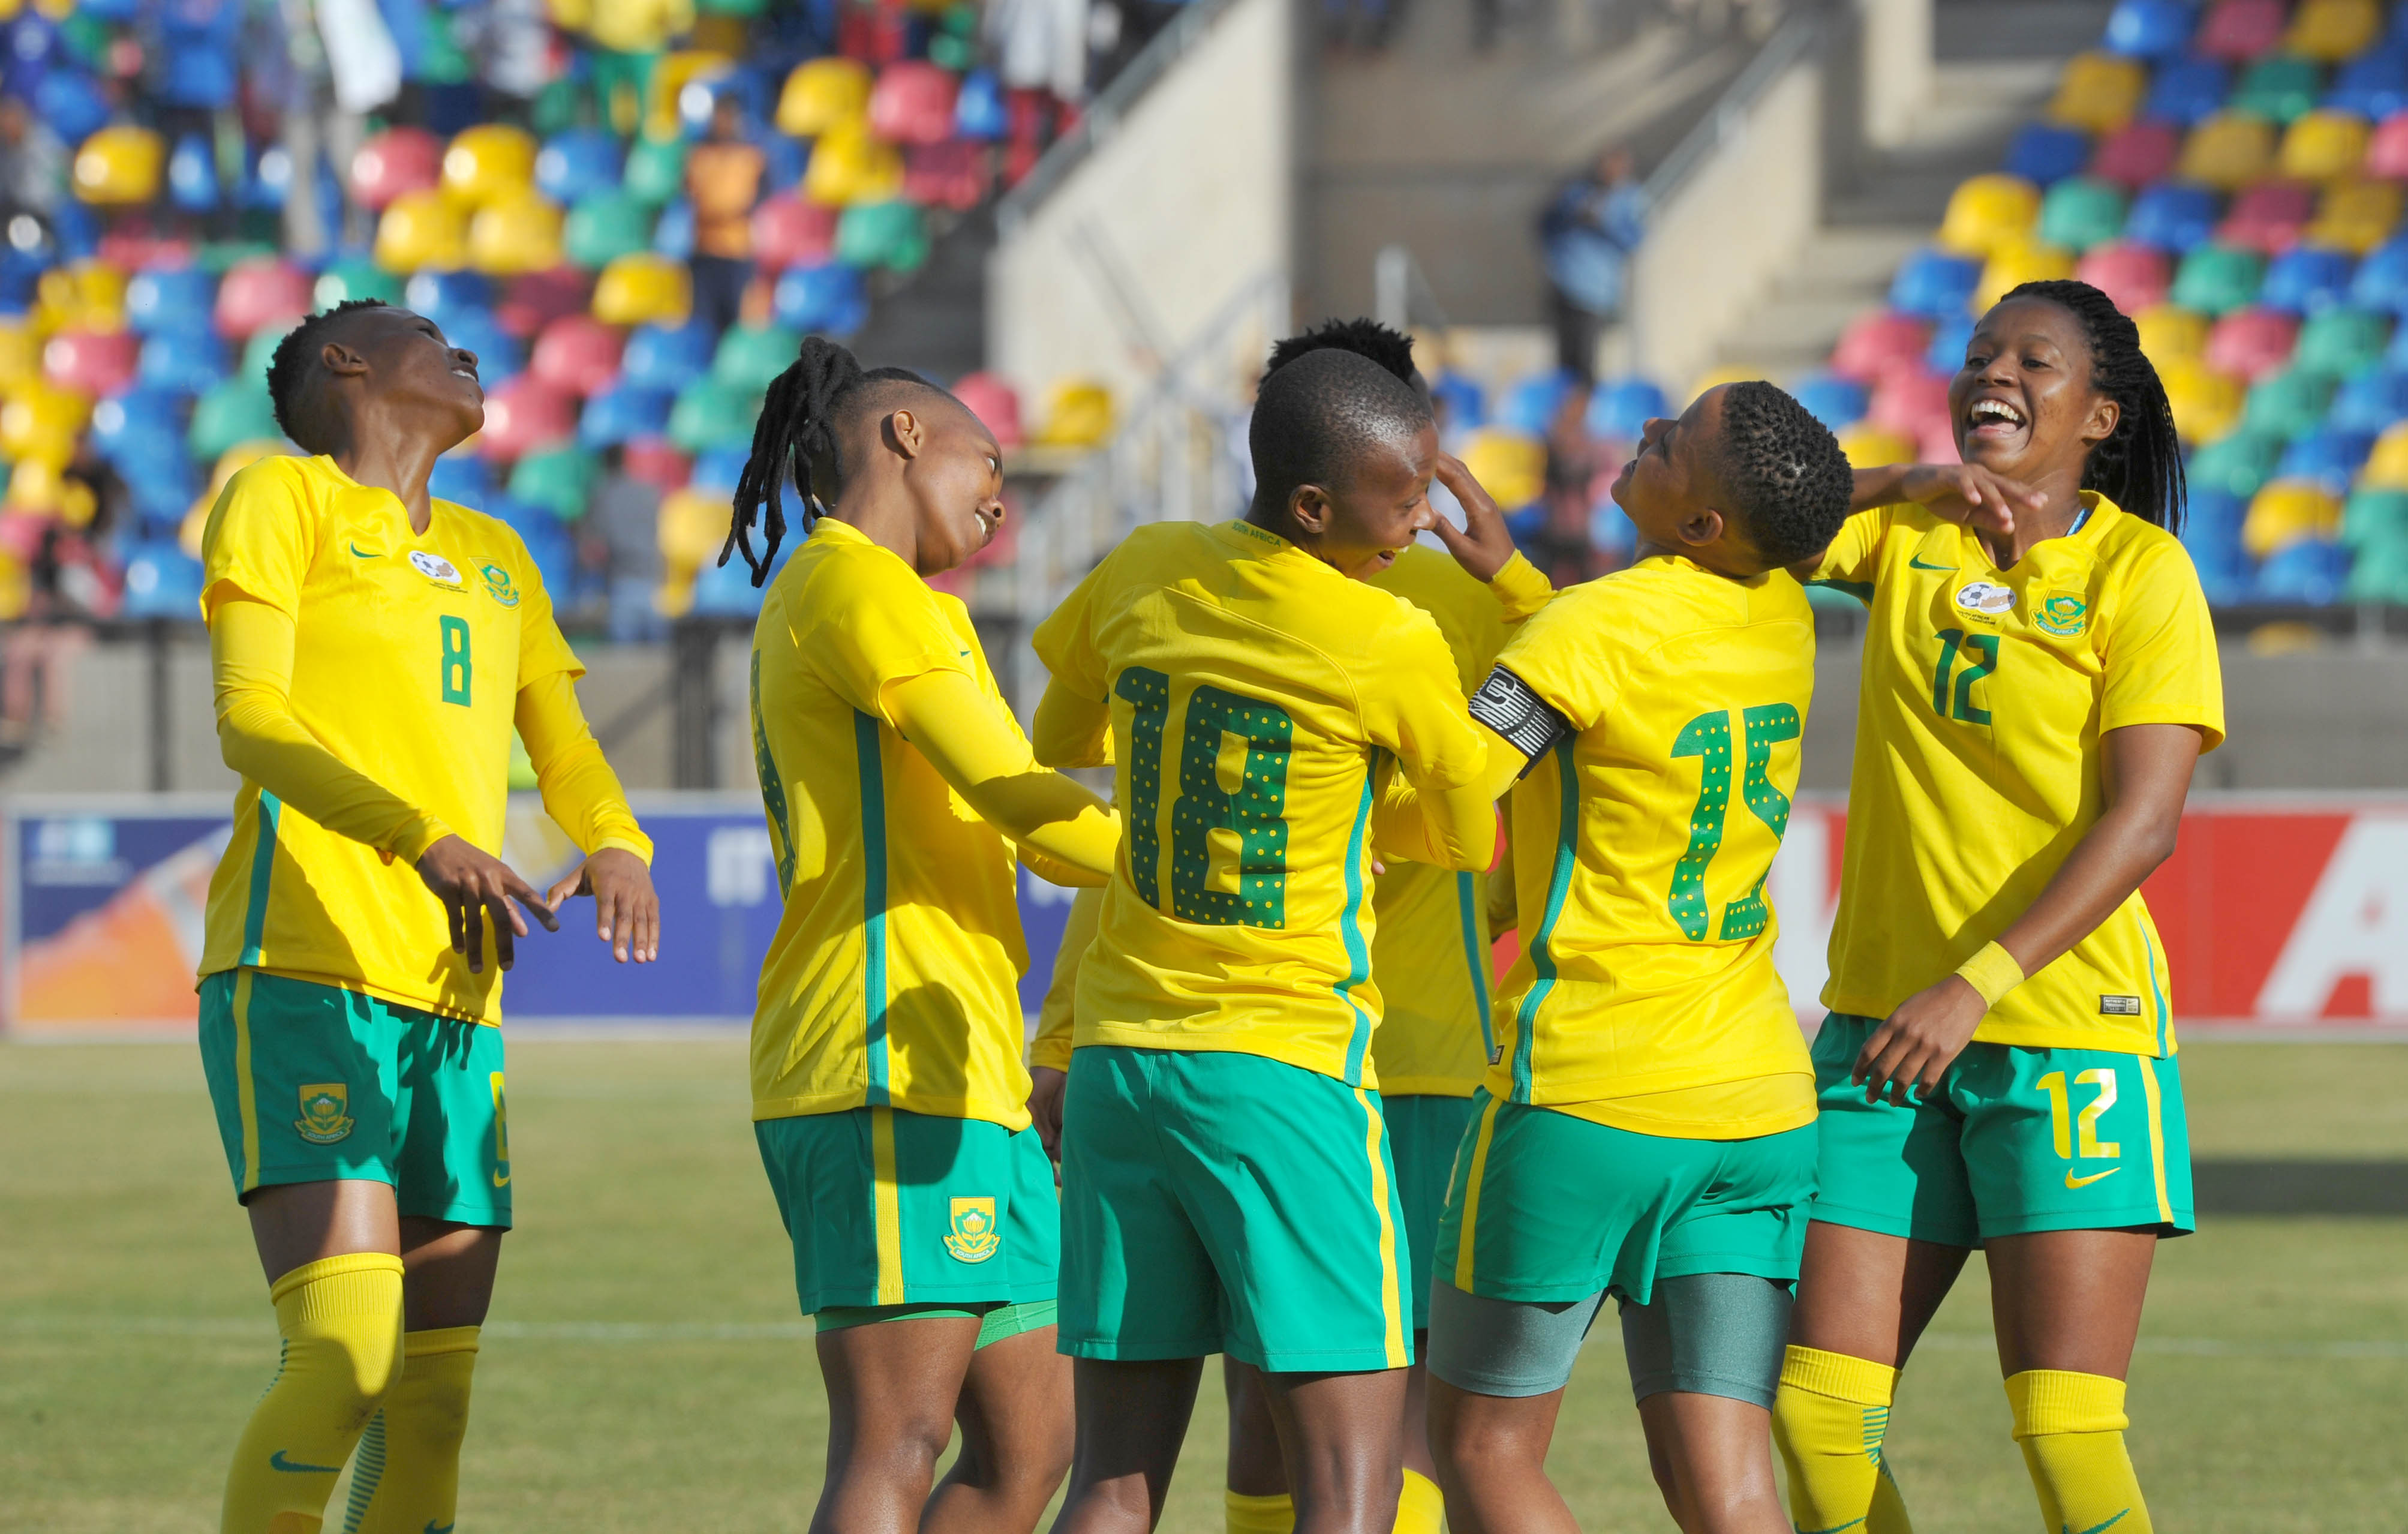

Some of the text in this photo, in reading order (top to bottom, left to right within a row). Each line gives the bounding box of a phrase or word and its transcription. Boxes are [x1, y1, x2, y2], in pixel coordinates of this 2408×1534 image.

[1250, 529, 1281, 548] AFRICA
[440, 614, 472, 707] 8
[1933, 628, 2000, 726] 12
[1114, 665, 1294, 930] 18
[1667, 702, 1800, 942] 15
[307, 1130, 344, 1140] SOUTH AFRICA
[2036, 1068, 2121, 1159] 12
[955, 1249, 991, 1259] SOUTH AFRICA
